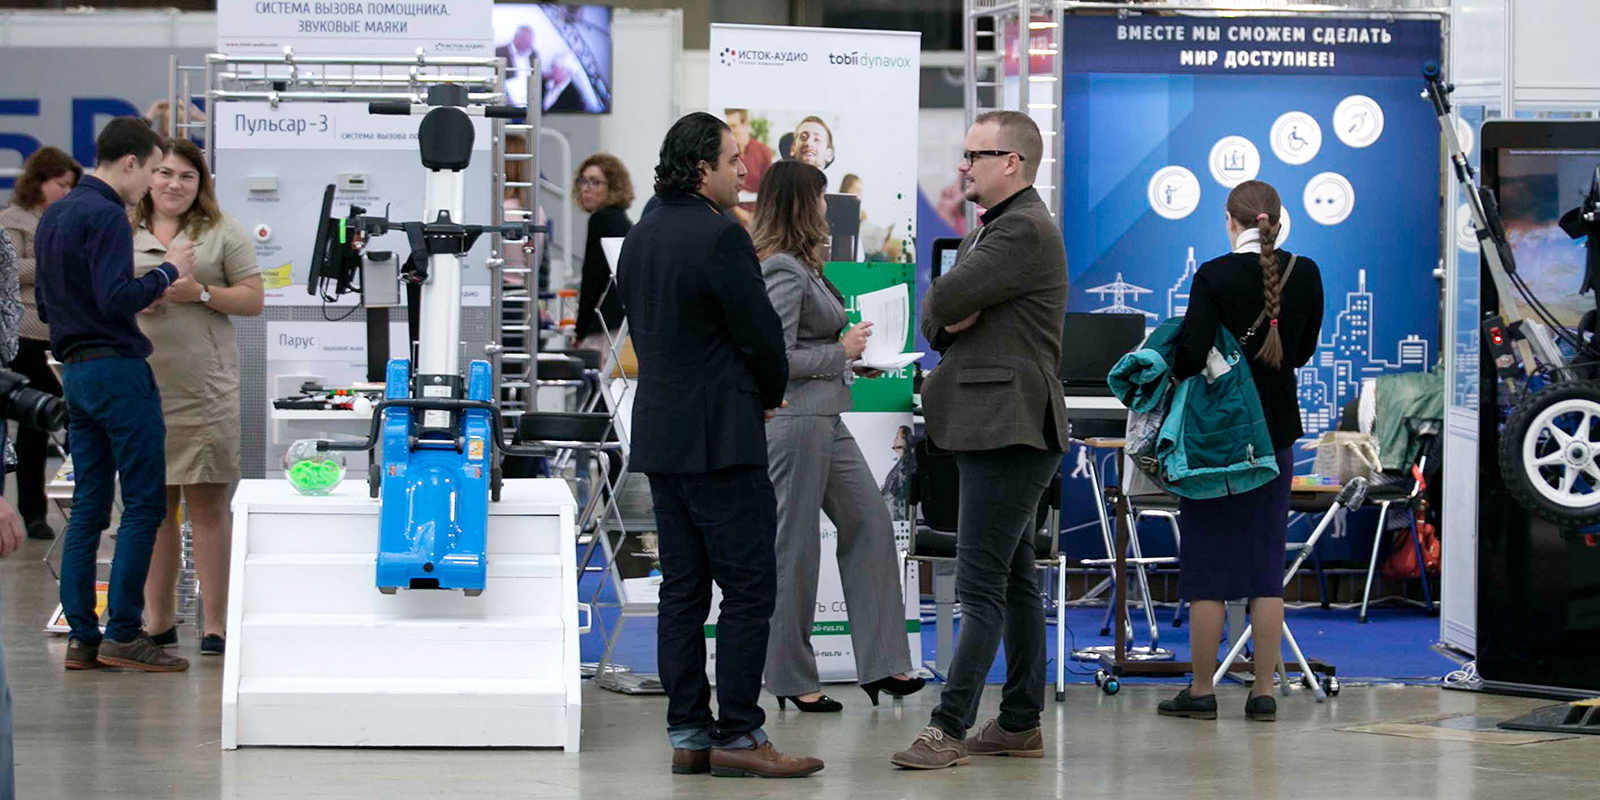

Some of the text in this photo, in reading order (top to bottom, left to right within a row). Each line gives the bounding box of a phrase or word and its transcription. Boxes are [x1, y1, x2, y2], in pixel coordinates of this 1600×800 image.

[255, 2, 450, 16] СИСТЕМА ВЫЗОВА ПОМОЩНИКА.
[298, 20, 408, 33] ЗВУКОВЫЕ МАЯКИ
[1117, 25, 1392, 45] ВМЕСТЕ МЫ СМОЖЕМ СДЕЛАТЬ
[738, 50, 808, 62] ИСТОК-АУДИО
[828, 51, 912, 69] tobii dynavox
[1180, 50, 1335, 69] МИР ДОСТУПНЕЕ!
[341, 132, 374, 140] система
[377, 132, 407, 140] вызова
[279, 334, 315, 349] Парус
